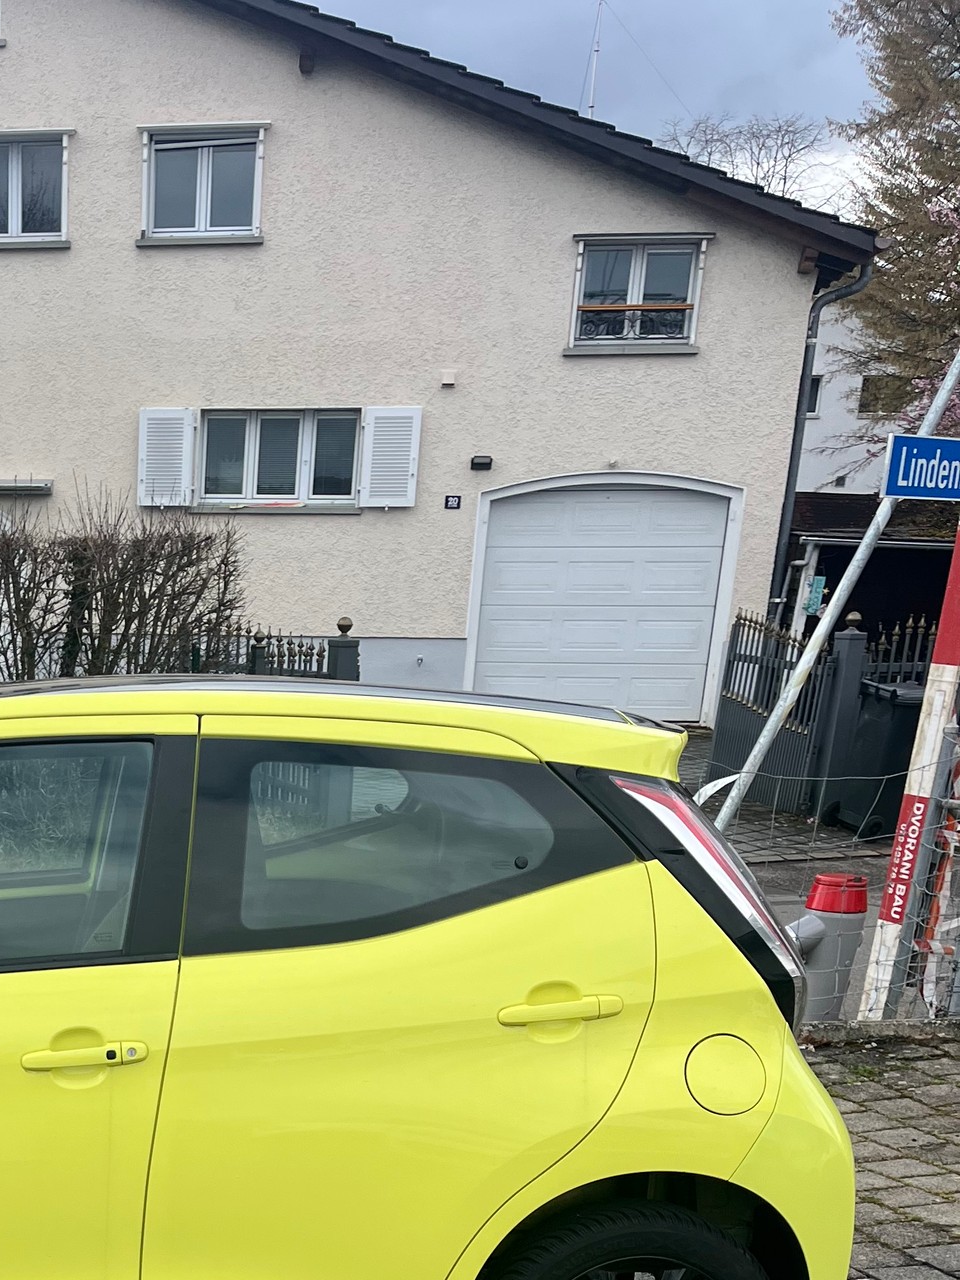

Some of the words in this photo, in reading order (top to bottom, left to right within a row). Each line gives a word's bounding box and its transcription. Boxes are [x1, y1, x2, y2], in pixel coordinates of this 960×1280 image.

[897, 446, 960, 489] Linden
[899, 802, 925, 880] DVORANI
[891, 883, 907, 919] BAU
